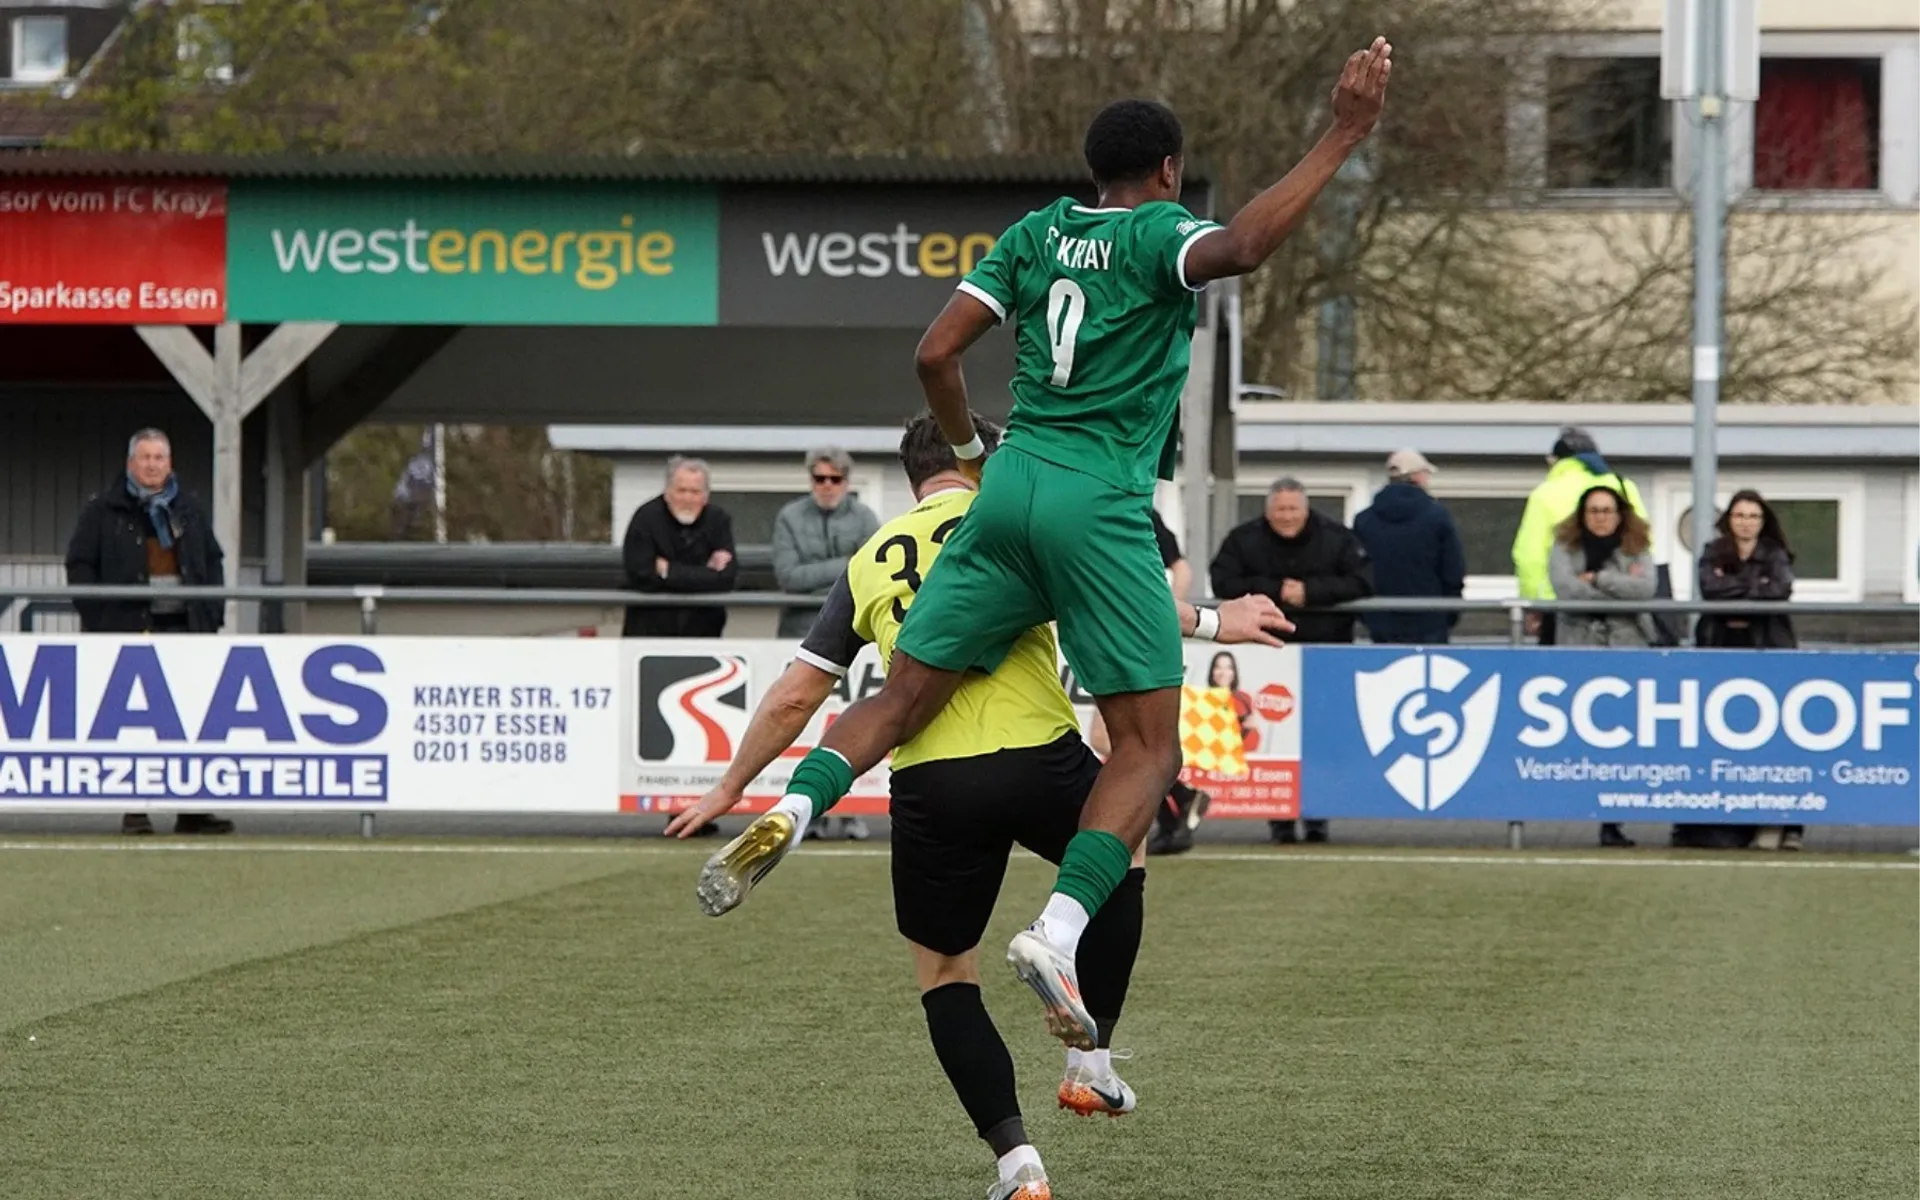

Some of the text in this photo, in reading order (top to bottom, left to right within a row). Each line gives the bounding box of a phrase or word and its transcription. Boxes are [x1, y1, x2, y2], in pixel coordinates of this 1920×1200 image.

[48, 191, 104, 212] vom
[113, 187, 145, 213] FC
[153, 189, 210, 219] Kray
[272, 217, 675, 290] westenergie
[761, 222, 995, 278] westen
[1057, 236, 1112, 270] KRAY
[0, 280, 218, 314] Sparkasse Essen
[0, 644, 388, 745] MAAS
[414, 686, 612, 709] KRAYER STR. 167
[414, 714, 567, 735] 45307 ESSEN
[1516, 675, 1912, 752] SCHOOF
[414, 741, 567, 763] 0201 595088
[0, 756, 384, 797] AHRZEUGTEILE
[1515, 758, 1911, 788] Versicherungen Finanzen Gastro
[1598, 791, 1828, 811] www.schoof-partner.de
